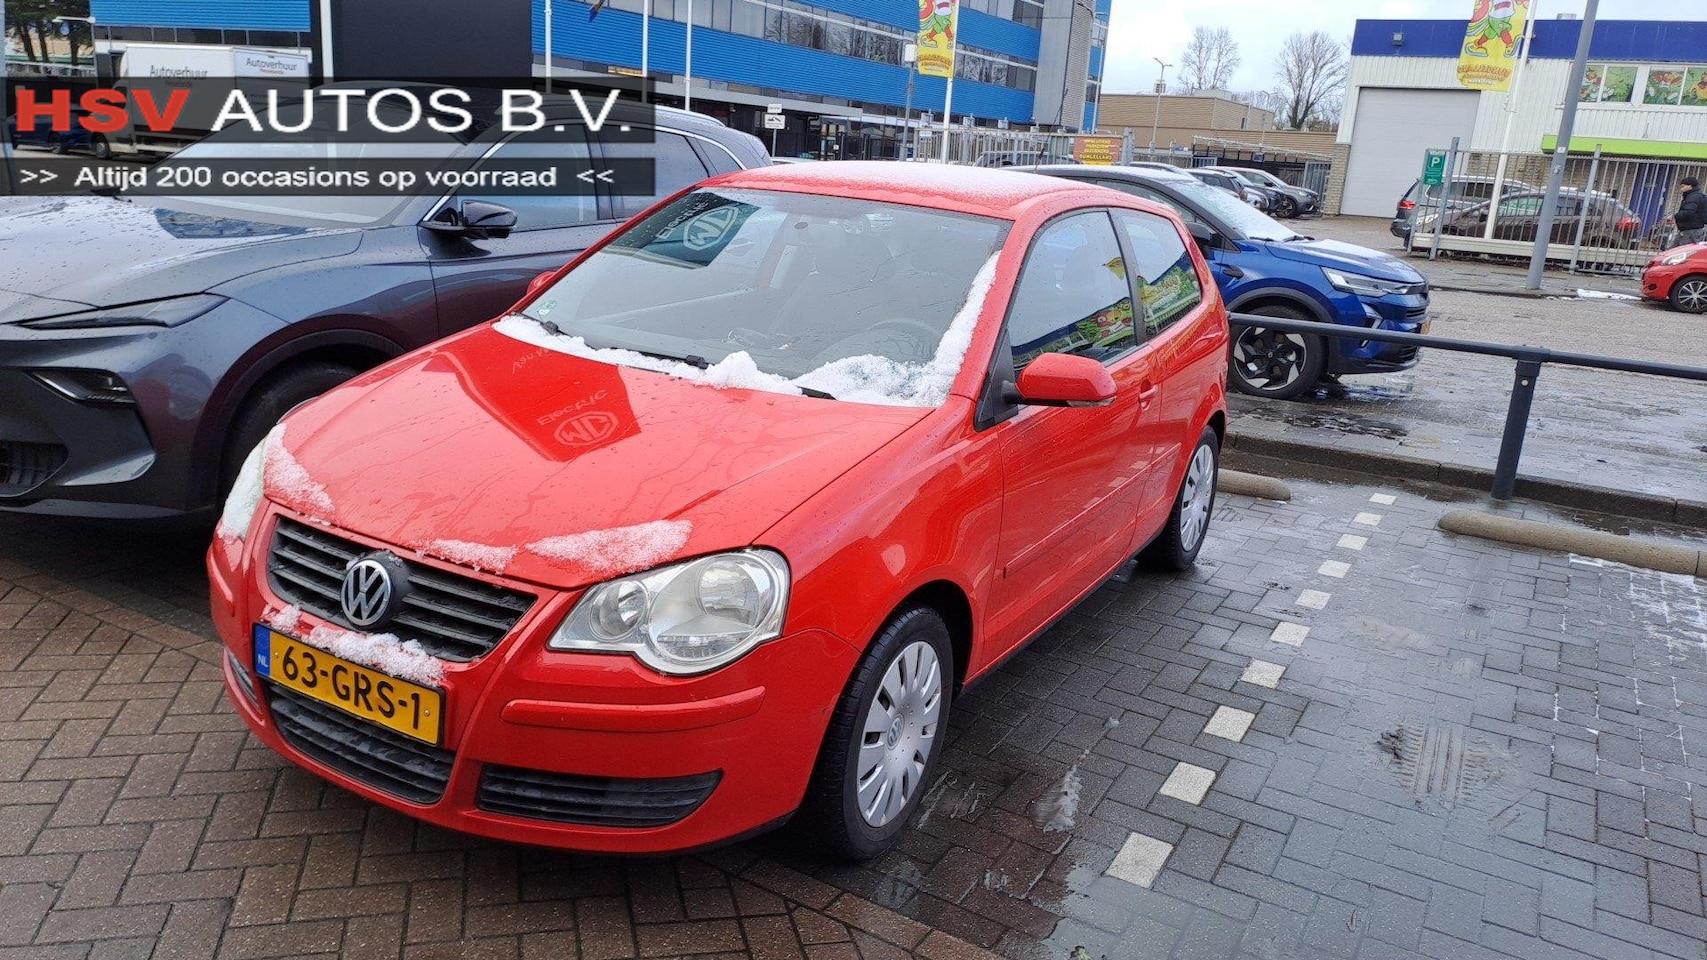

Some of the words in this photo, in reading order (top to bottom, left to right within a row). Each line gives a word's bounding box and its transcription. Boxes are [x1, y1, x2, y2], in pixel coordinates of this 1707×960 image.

[245, 57, 298, 71] Autoverhuur
[150, 65, 208, 79] Autoverhuur
[257, 653, 269, 668] NL
[282, 646, 421, 730] 63-GRS-1
